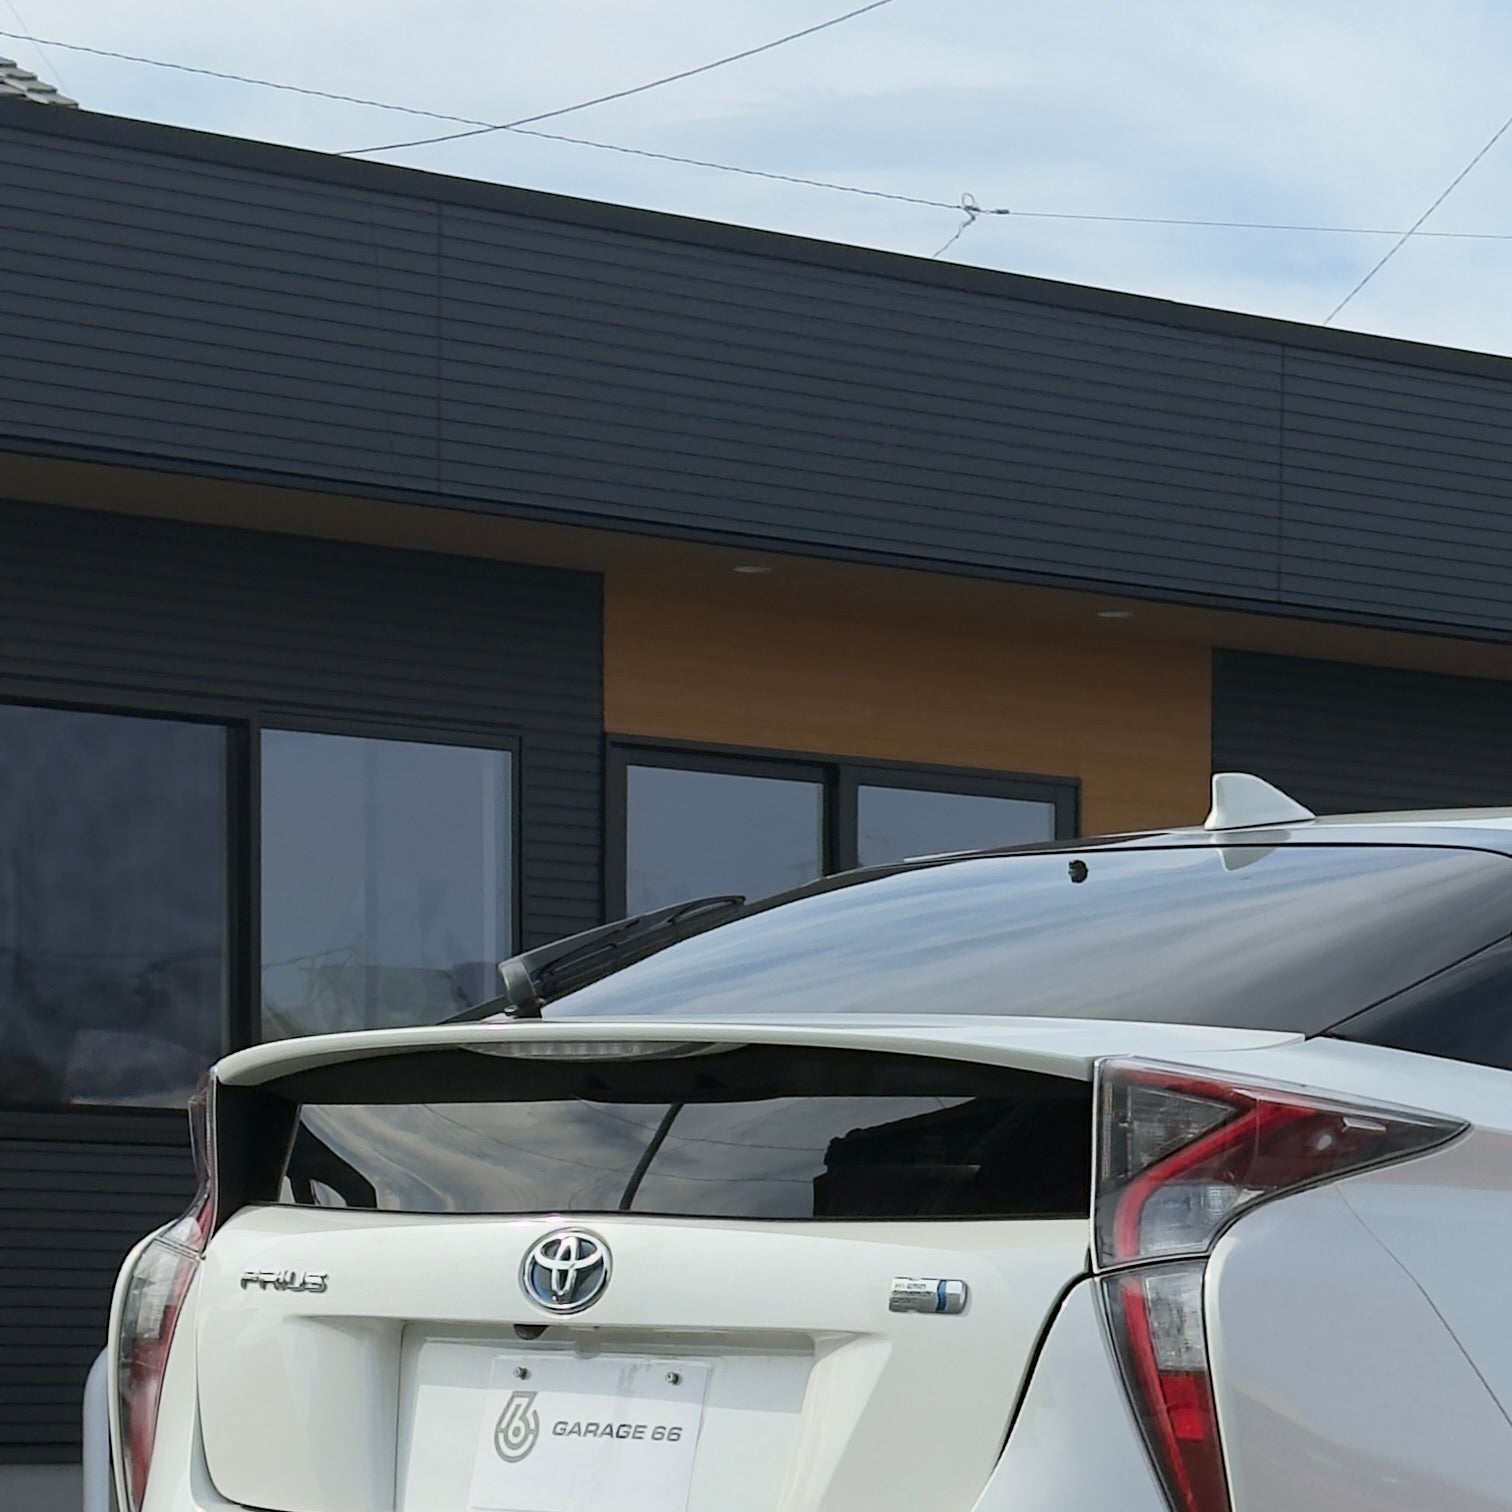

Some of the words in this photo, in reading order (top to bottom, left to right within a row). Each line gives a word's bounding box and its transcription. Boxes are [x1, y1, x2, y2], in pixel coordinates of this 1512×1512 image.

[240, 1270, 328, 1293] PRIUS
[552, 1421, 648, 1440] GARAGE
[651, 1425, 683, 1442] 66
